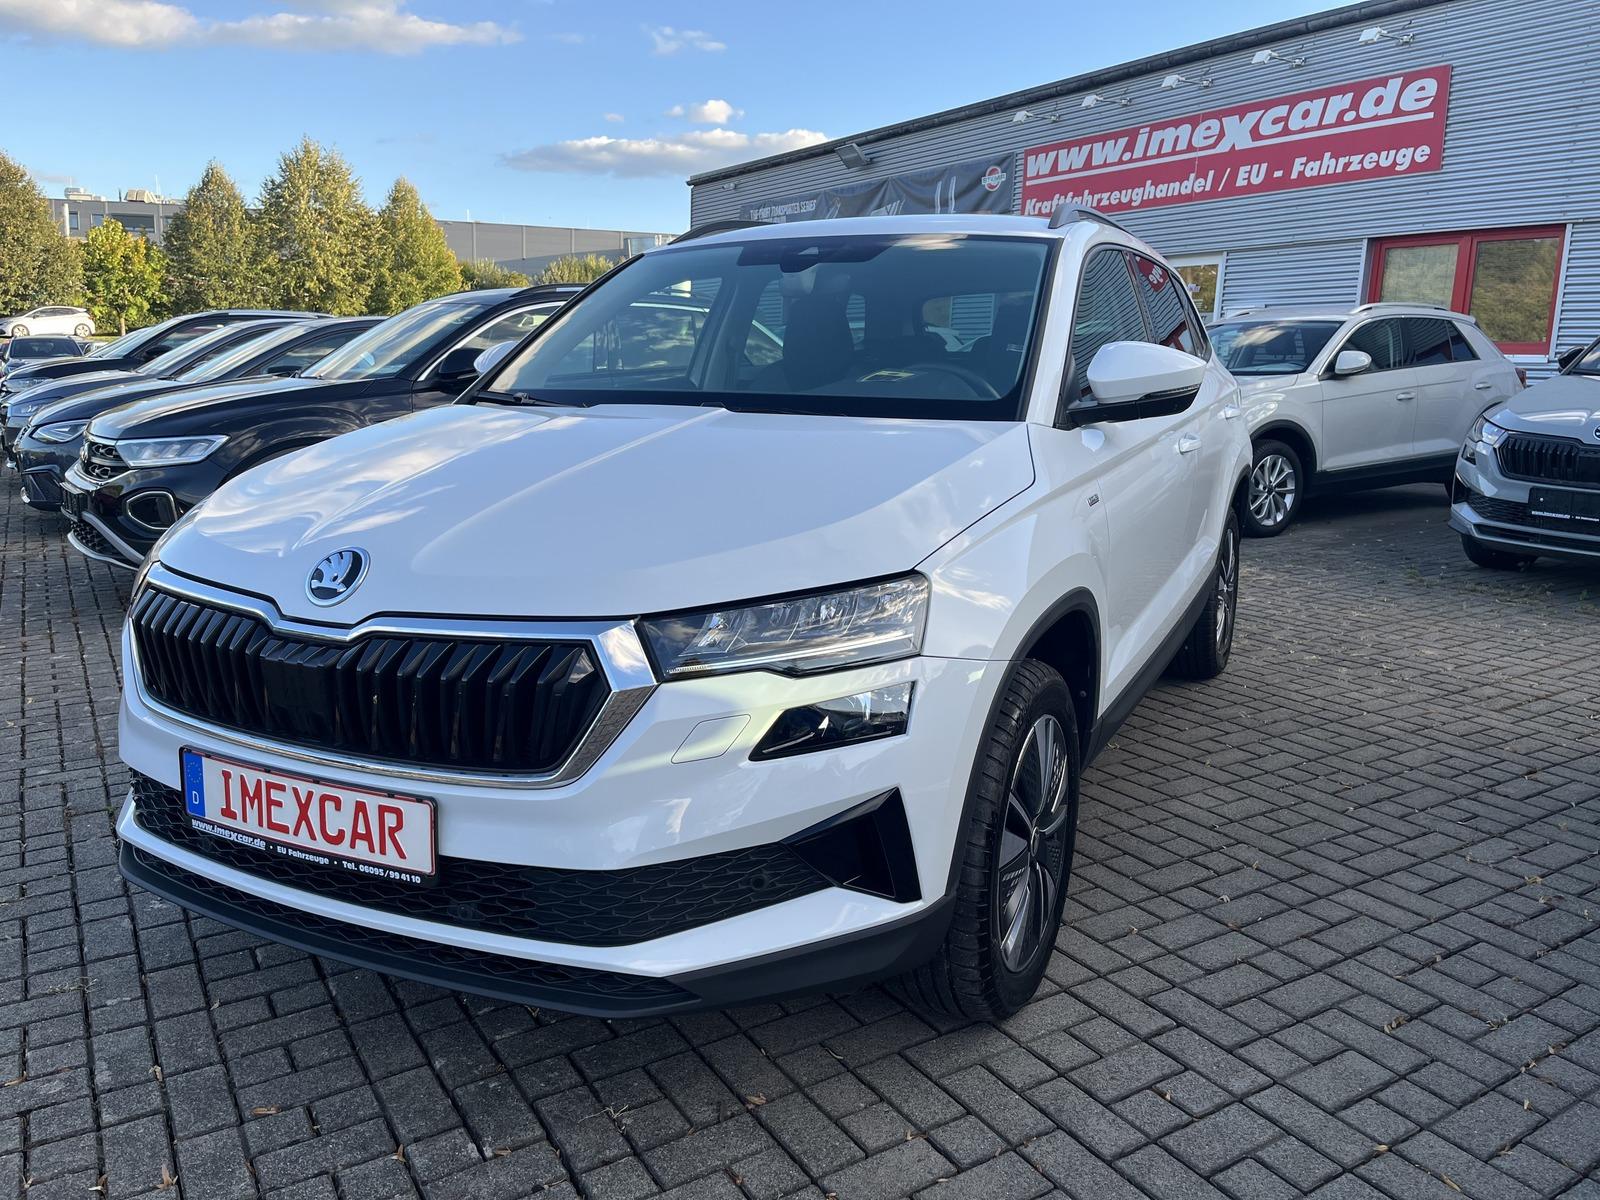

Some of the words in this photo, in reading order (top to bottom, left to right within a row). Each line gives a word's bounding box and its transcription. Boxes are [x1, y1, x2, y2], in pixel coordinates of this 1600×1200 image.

[1026, 77, 1438, 178] www.imexcar.de
[1218, 168, 1231, 191] /
[1236, 163, 1268, 187] EU
[1273, 170, 1284, 178] -
[1290, 144, 1431, 180] Fahrzeuge
[192, 790, 199, 805] D
[220, 769, 407, 860] IMEXCAR
[191, 819, 266, 849] www.imexcar.de
[277, 846, 287, 854] EU
[288, 849, 329, 865] Fahrzeuge
[342, 861, 357, 871] Tel.
